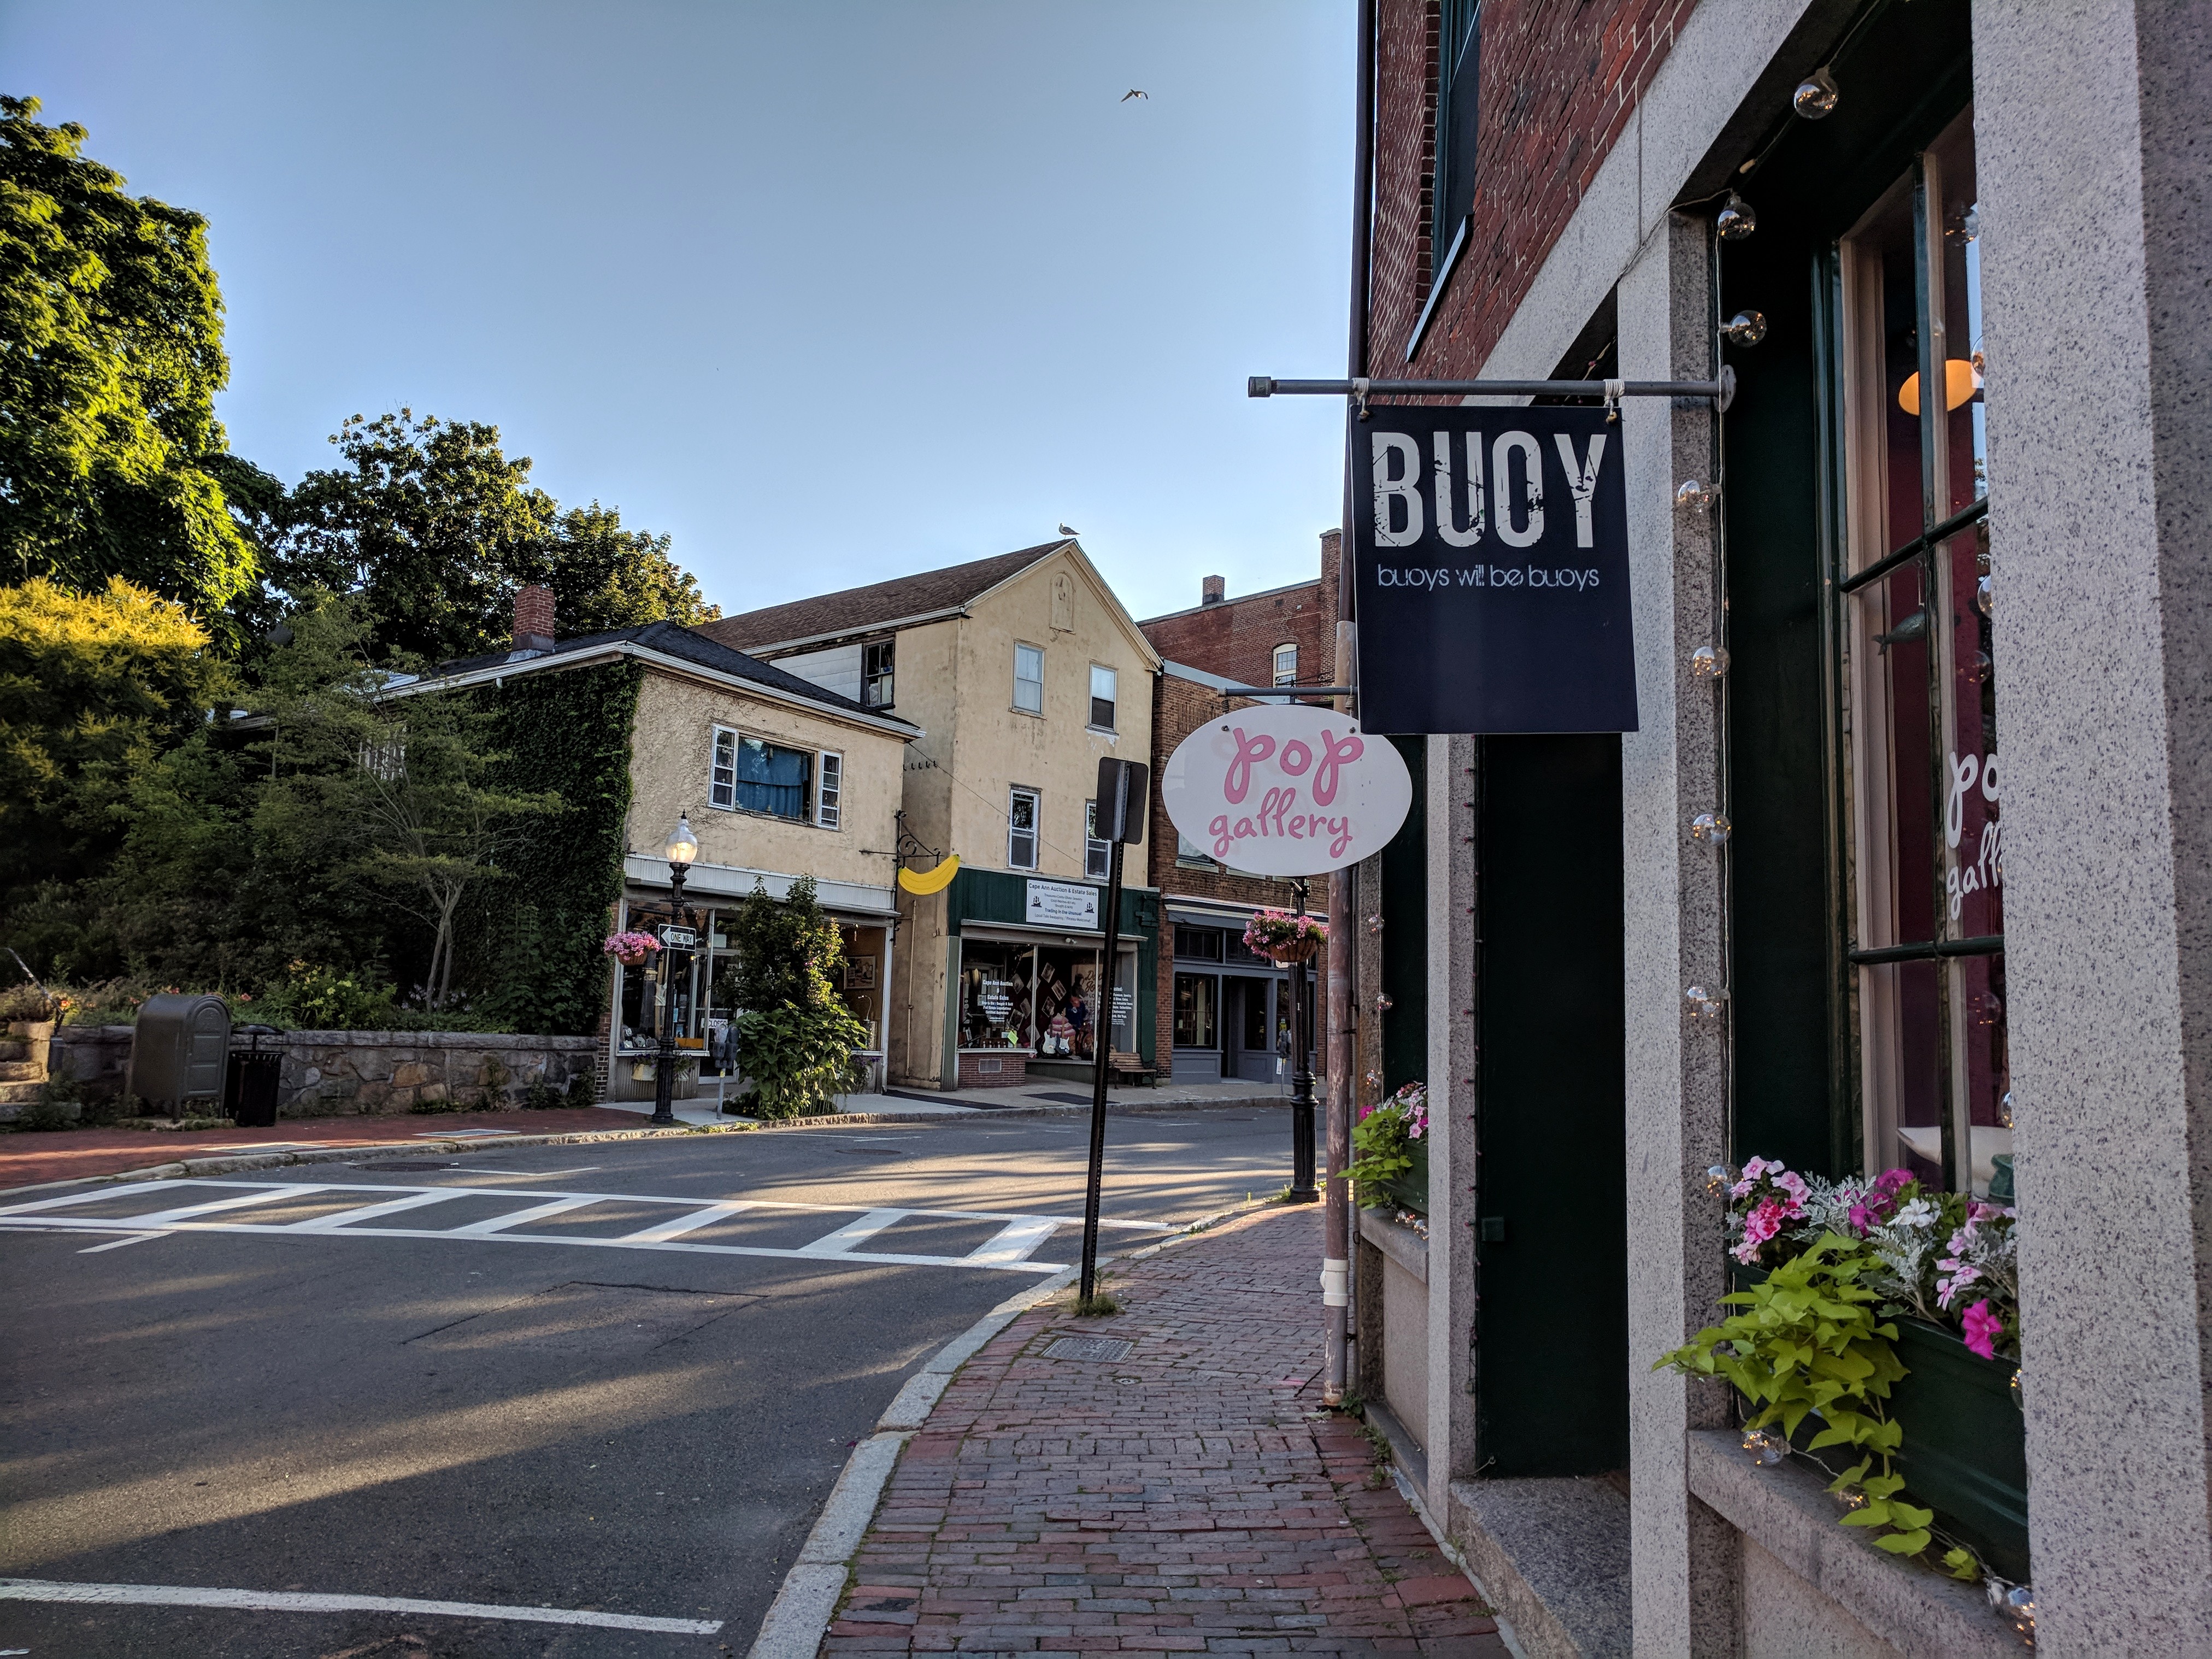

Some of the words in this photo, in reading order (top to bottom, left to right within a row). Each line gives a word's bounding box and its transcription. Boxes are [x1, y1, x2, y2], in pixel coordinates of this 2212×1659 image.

[1372, 431, 1607, 548] BUOY
[1378, 564, 1450, 591] buoys
[1456, 564, 1485, 587] will
[1490, 564, 1523, 587] be
[1529, 564, 1600, 592] buoys
[1224, 727, 1364, 807] pop
[1947, 751, 2000, 849] po
[1209, 787, 1352, 858] gallery
[1947, 821, 2003, 920] gall
[670, 933, 681, 942] ONE
[683, 934, 693, 943] WAY
